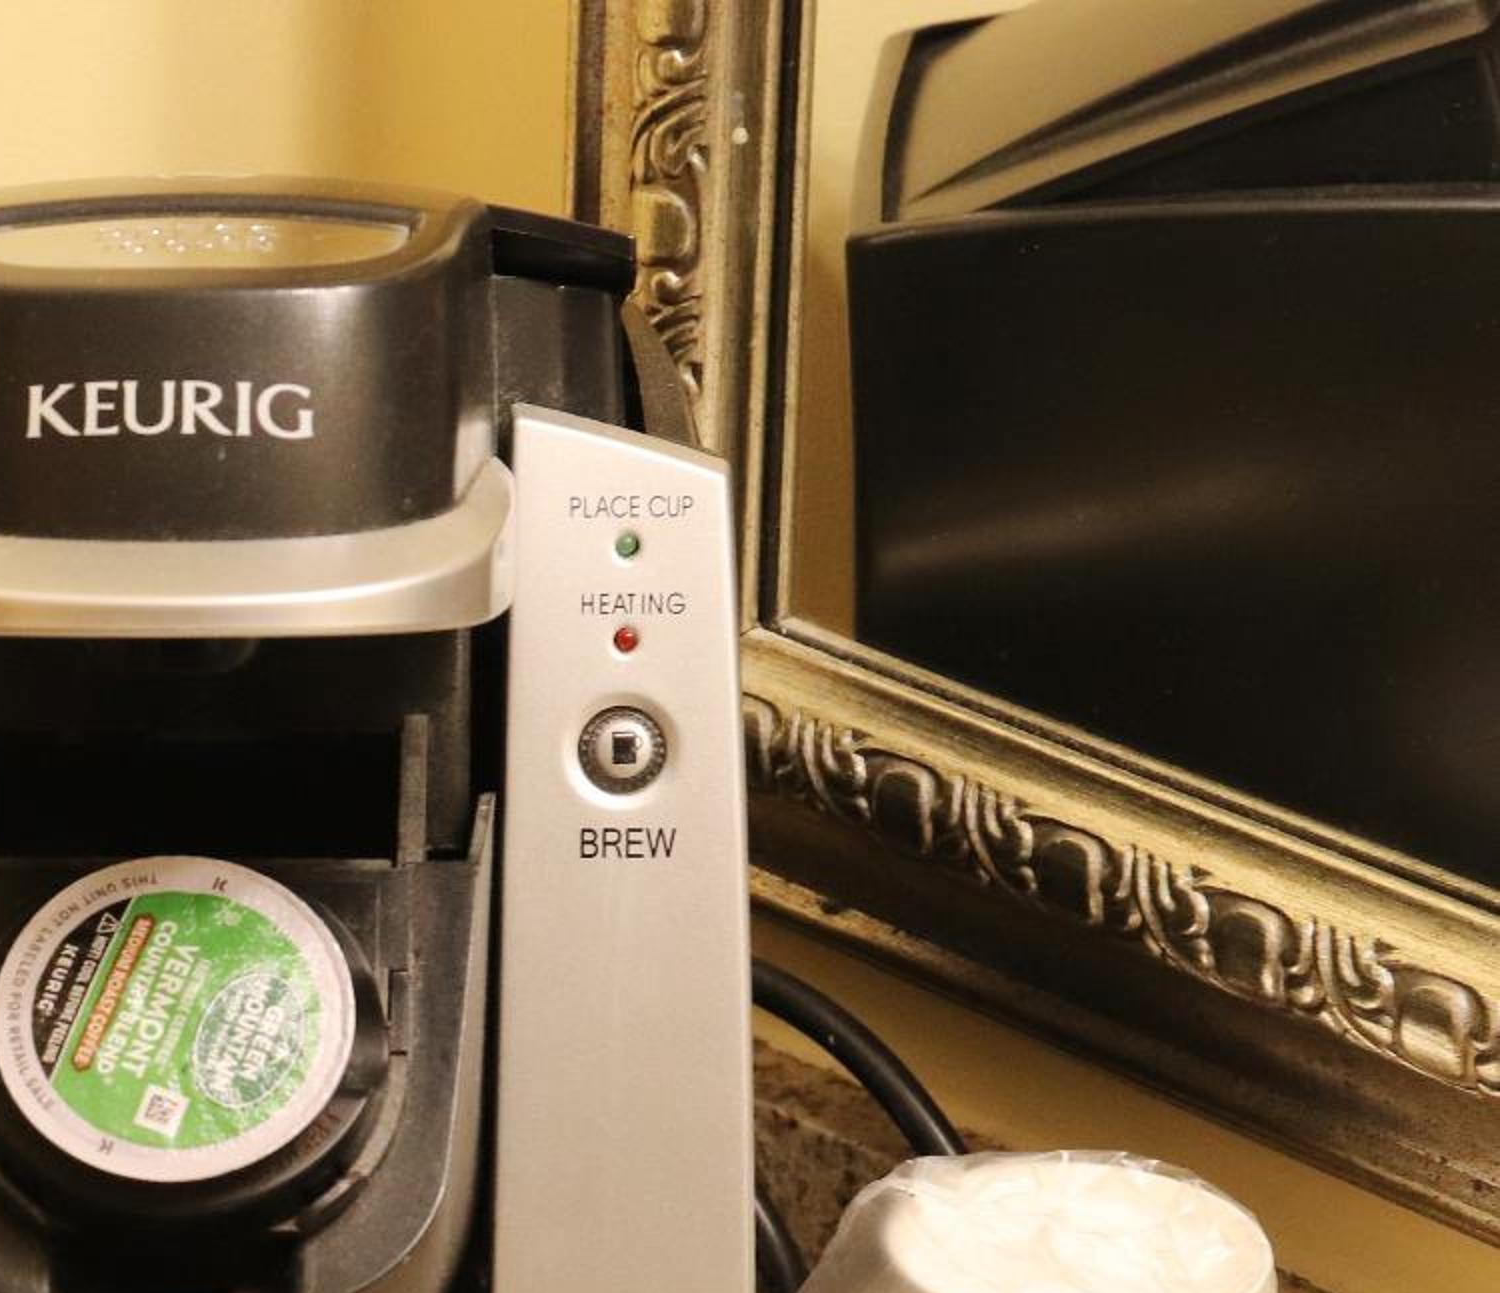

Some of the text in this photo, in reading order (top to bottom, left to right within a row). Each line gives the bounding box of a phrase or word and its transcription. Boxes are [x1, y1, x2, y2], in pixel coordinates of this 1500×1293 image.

[26, 380, 314, 439] KEURIG
[569, 495, 694, 519] PLACE CUP
[581, 592, 687, 616] HEATING
[580, 827, 677, 860] BREW
[83, 883, 117, 905] UNIT
[122, 873, 158, 888] THIS
[52, 903, 81, 927] NOT
[37, 944, 79, 1017] KEURIG
[7, 993, 22, 1020] FOR
[120, 944, 201, 1079] VERMONT
[97, 1009, 136, 1074] BLEND
[243, 1004, 285, 1081] GREEN
